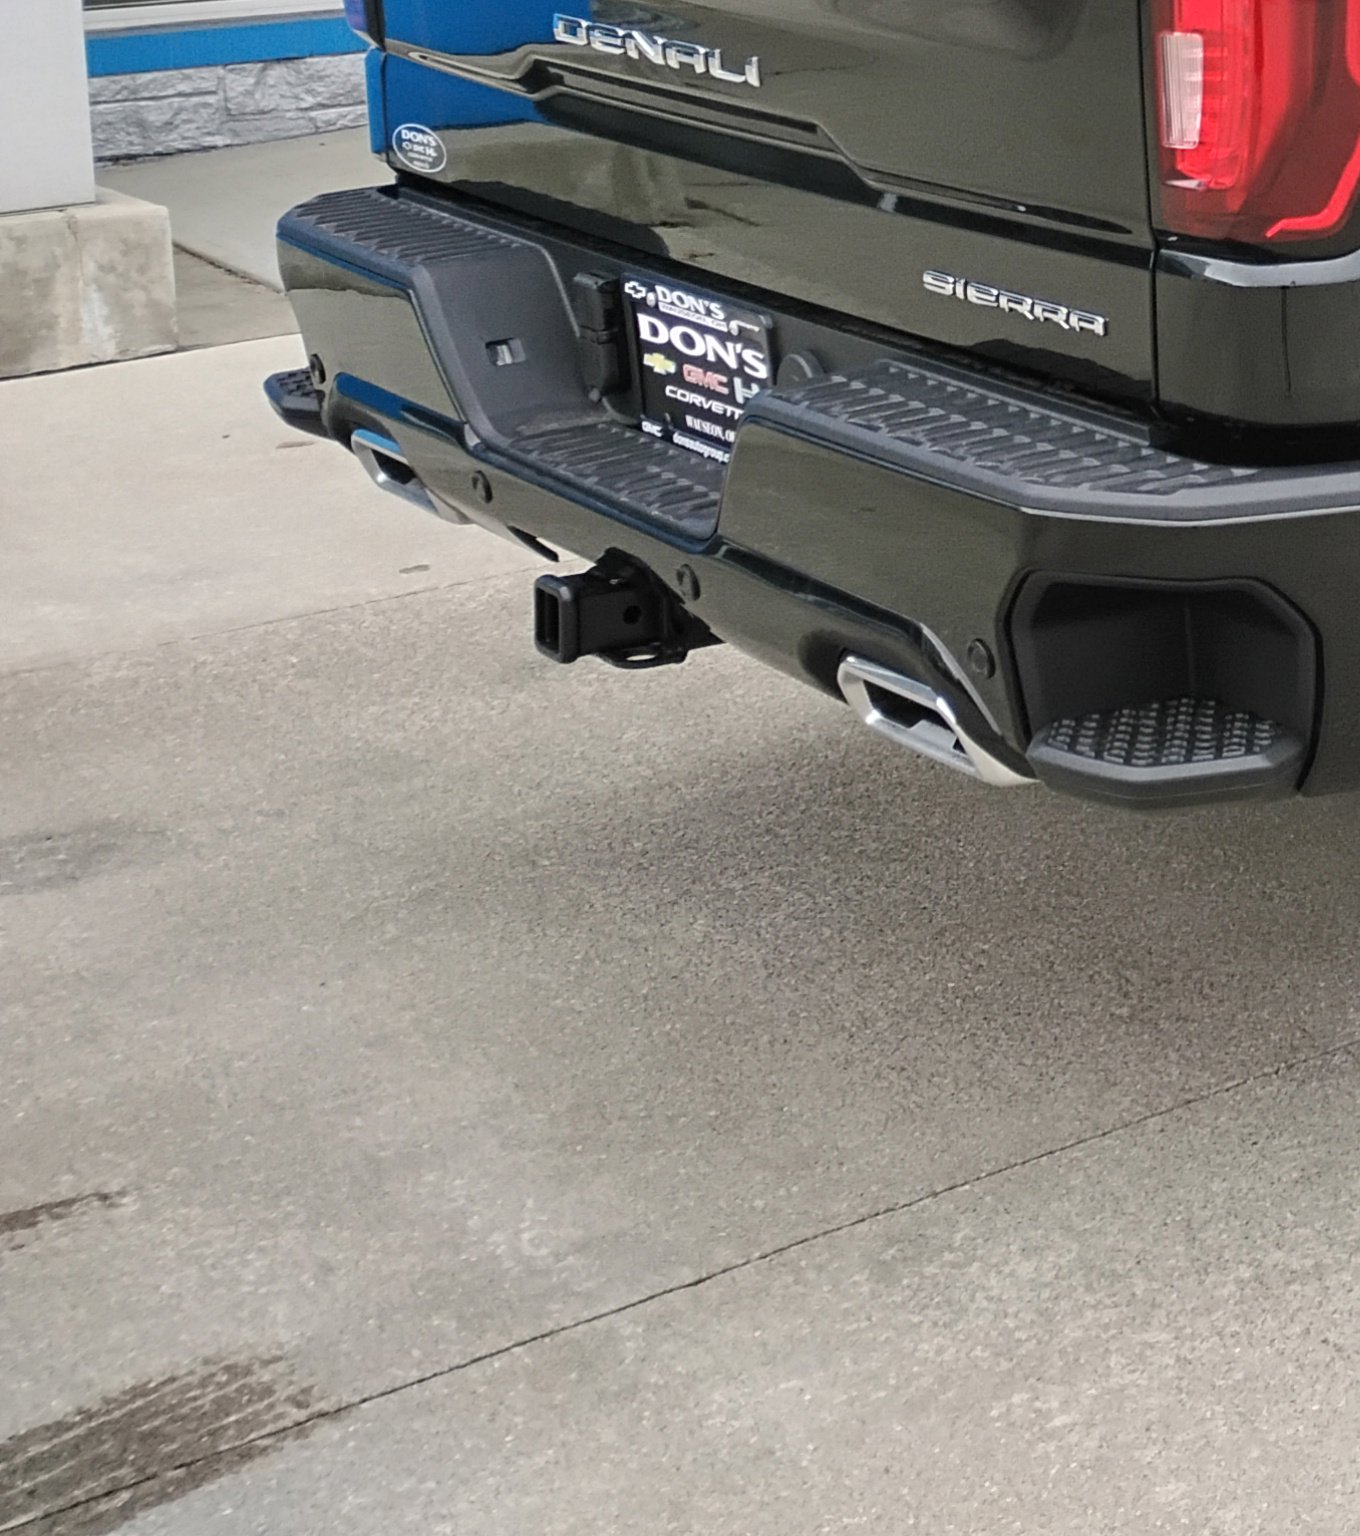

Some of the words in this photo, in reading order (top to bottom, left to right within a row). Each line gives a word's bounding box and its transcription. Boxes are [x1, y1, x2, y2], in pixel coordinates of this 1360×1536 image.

[553, 13, 761, 87] DENALI
[654, 284, 725, 320] DON'S
[922, 269, 1108, 337] SIERRA
[637, 313, 769, 379] DON'S
[665, 385, 745, 421] CORVETT
[683, 363, 729, 395] GMC
